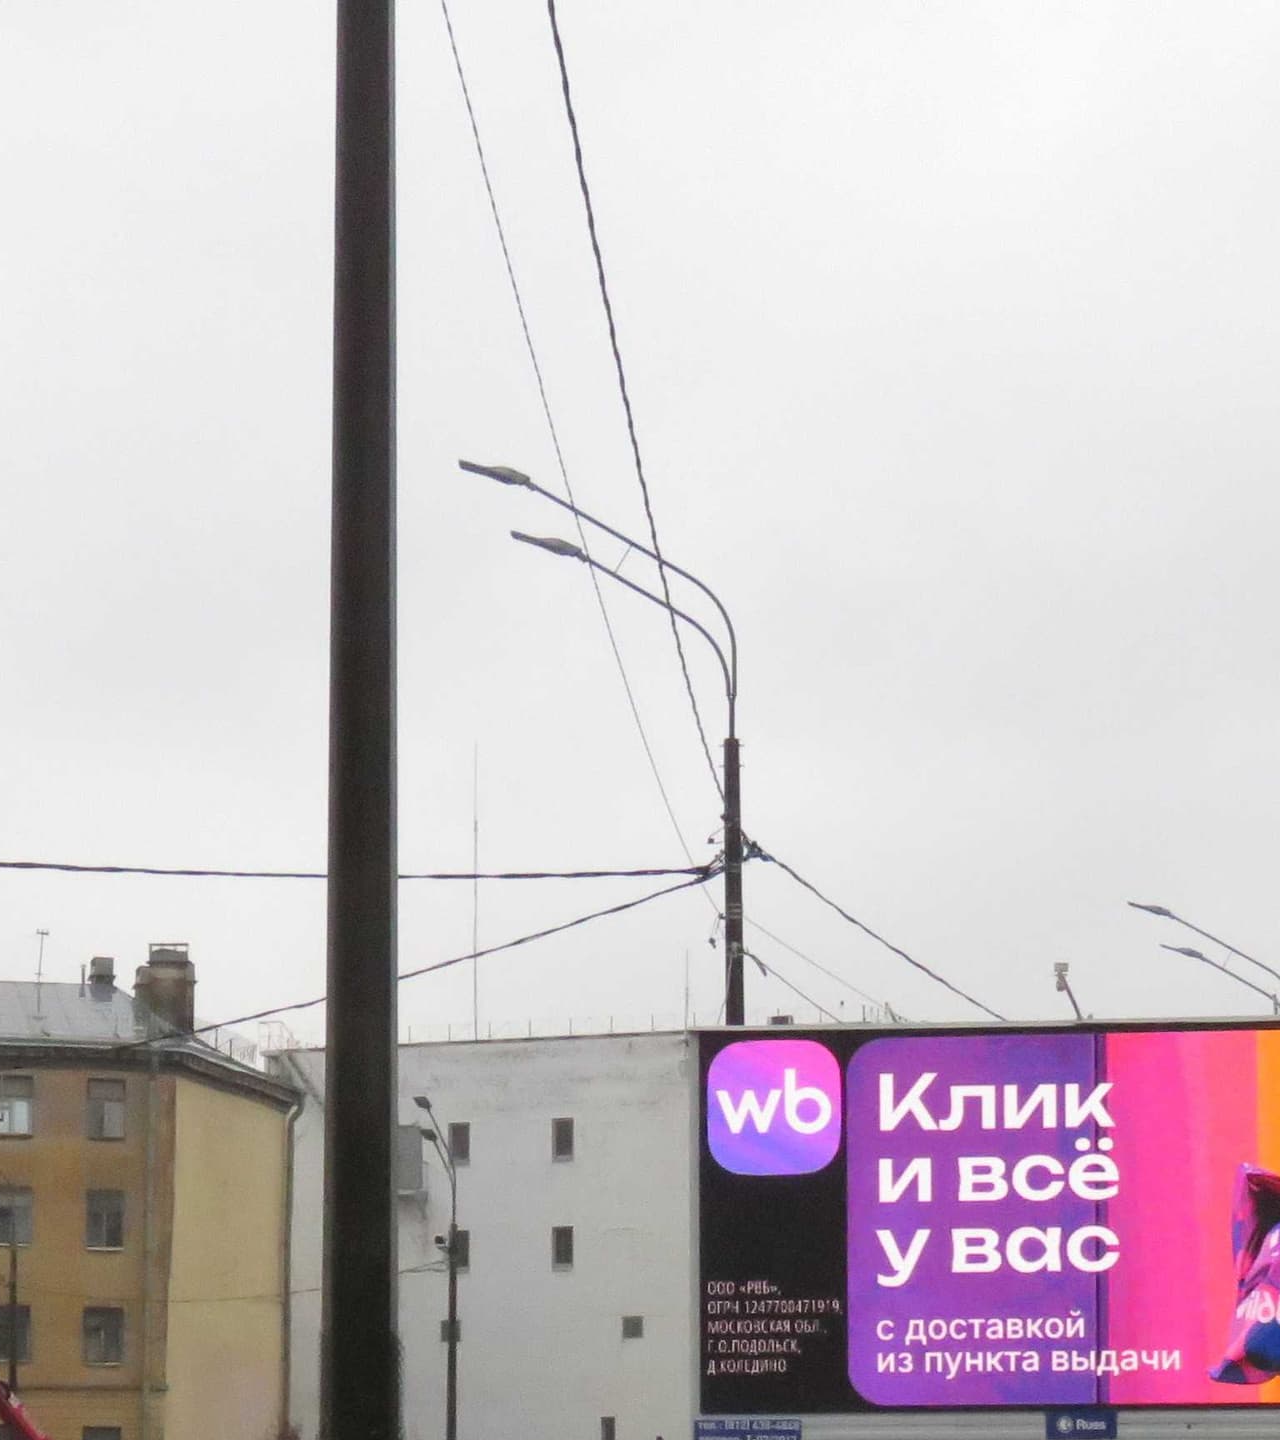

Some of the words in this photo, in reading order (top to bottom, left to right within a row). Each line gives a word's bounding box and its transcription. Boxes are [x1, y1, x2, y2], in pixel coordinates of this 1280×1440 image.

[716, 1068, 833, 1135] wb
[877, 1072, 1116, 1132] Клик
[877, 1157, 933, 1204] и
[956, 1136, 1120, 1203] всё
[875, 1228, 931, 1289] у
[949, 1224, 1121, 1274] вас
[875, 1319, 895, 1341] с
[904, 1310, 1086, 1345] доставкой
[876, 1352, 914, 1373] из
[924, 1350, 1040, 1380] пункта
[1051, 1349, 1182, 1377] выдачи
